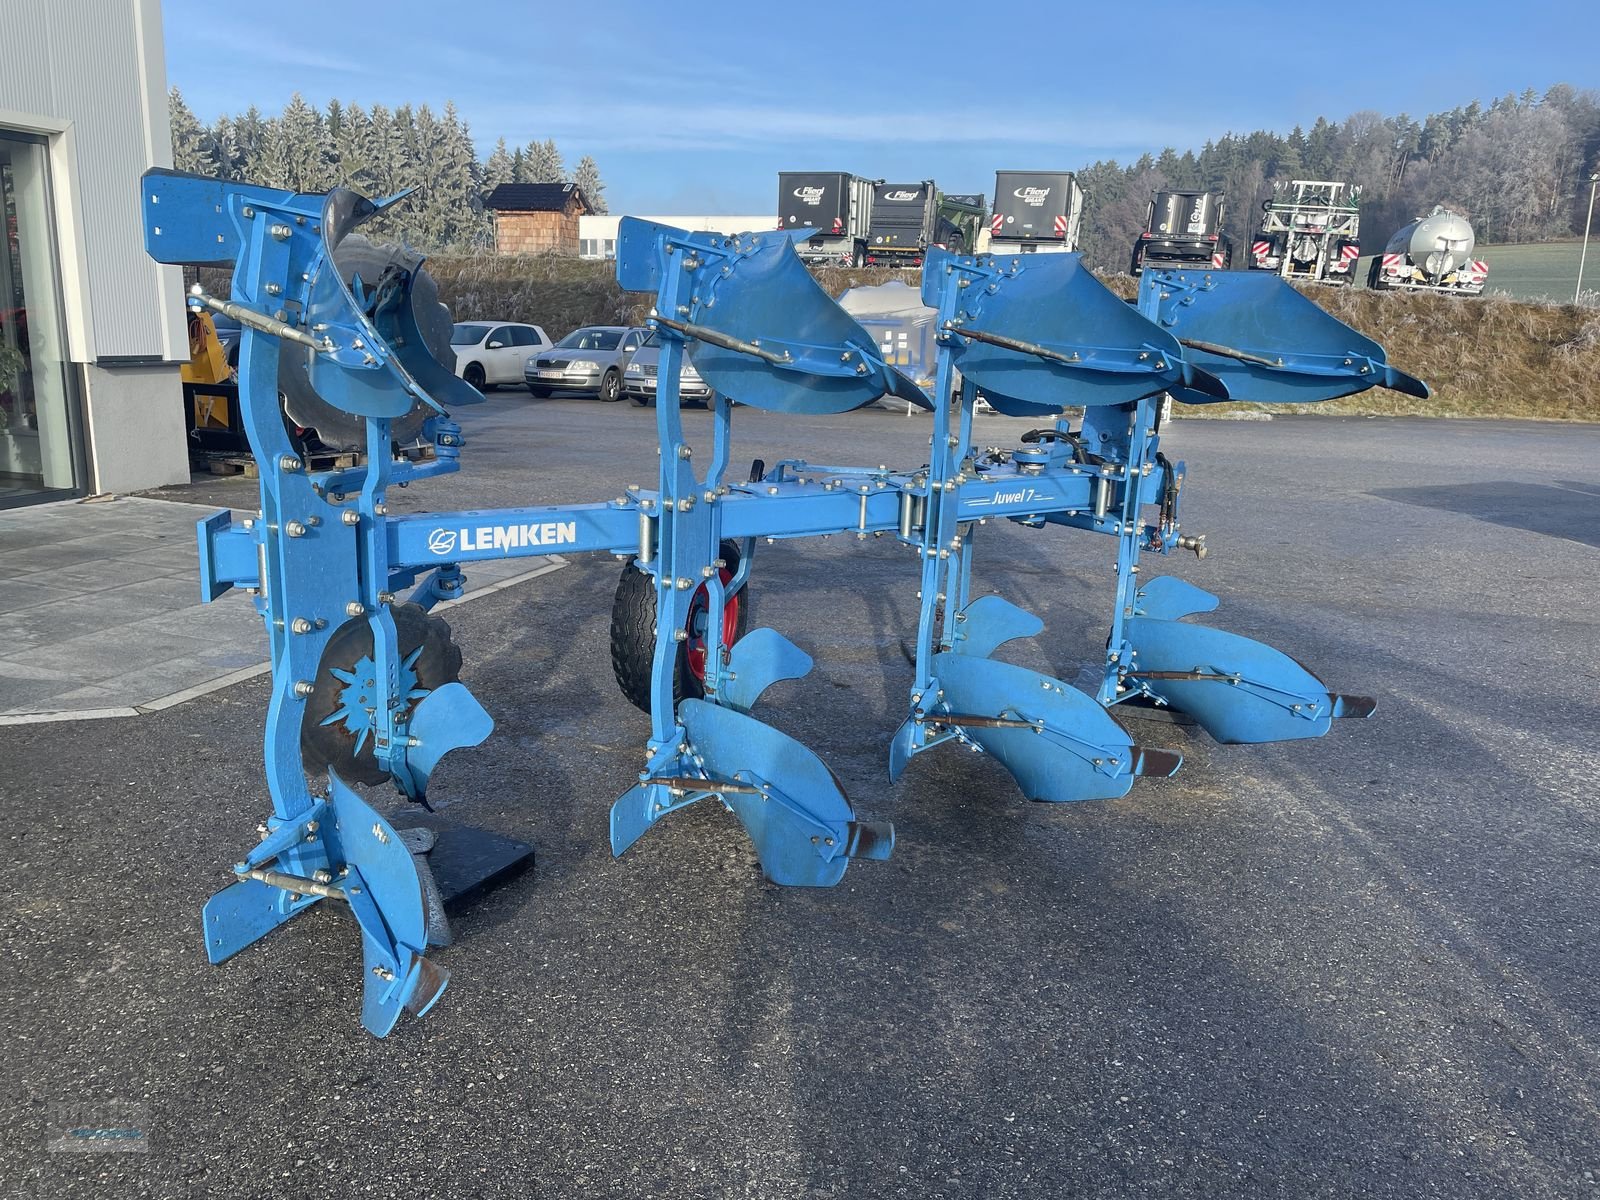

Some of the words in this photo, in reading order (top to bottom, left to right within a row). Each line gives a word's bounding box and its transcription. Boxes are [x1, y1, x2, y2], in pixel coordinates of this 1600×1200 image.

[894, 190, 919, 199] Fliegl
[1024, 186, 1051, 197] Fliegl
[991, 488, 1026, 505] Juwel
[1026, 489, 1035, 502] 7
[460, 521, 576, 553] LEMKEN
